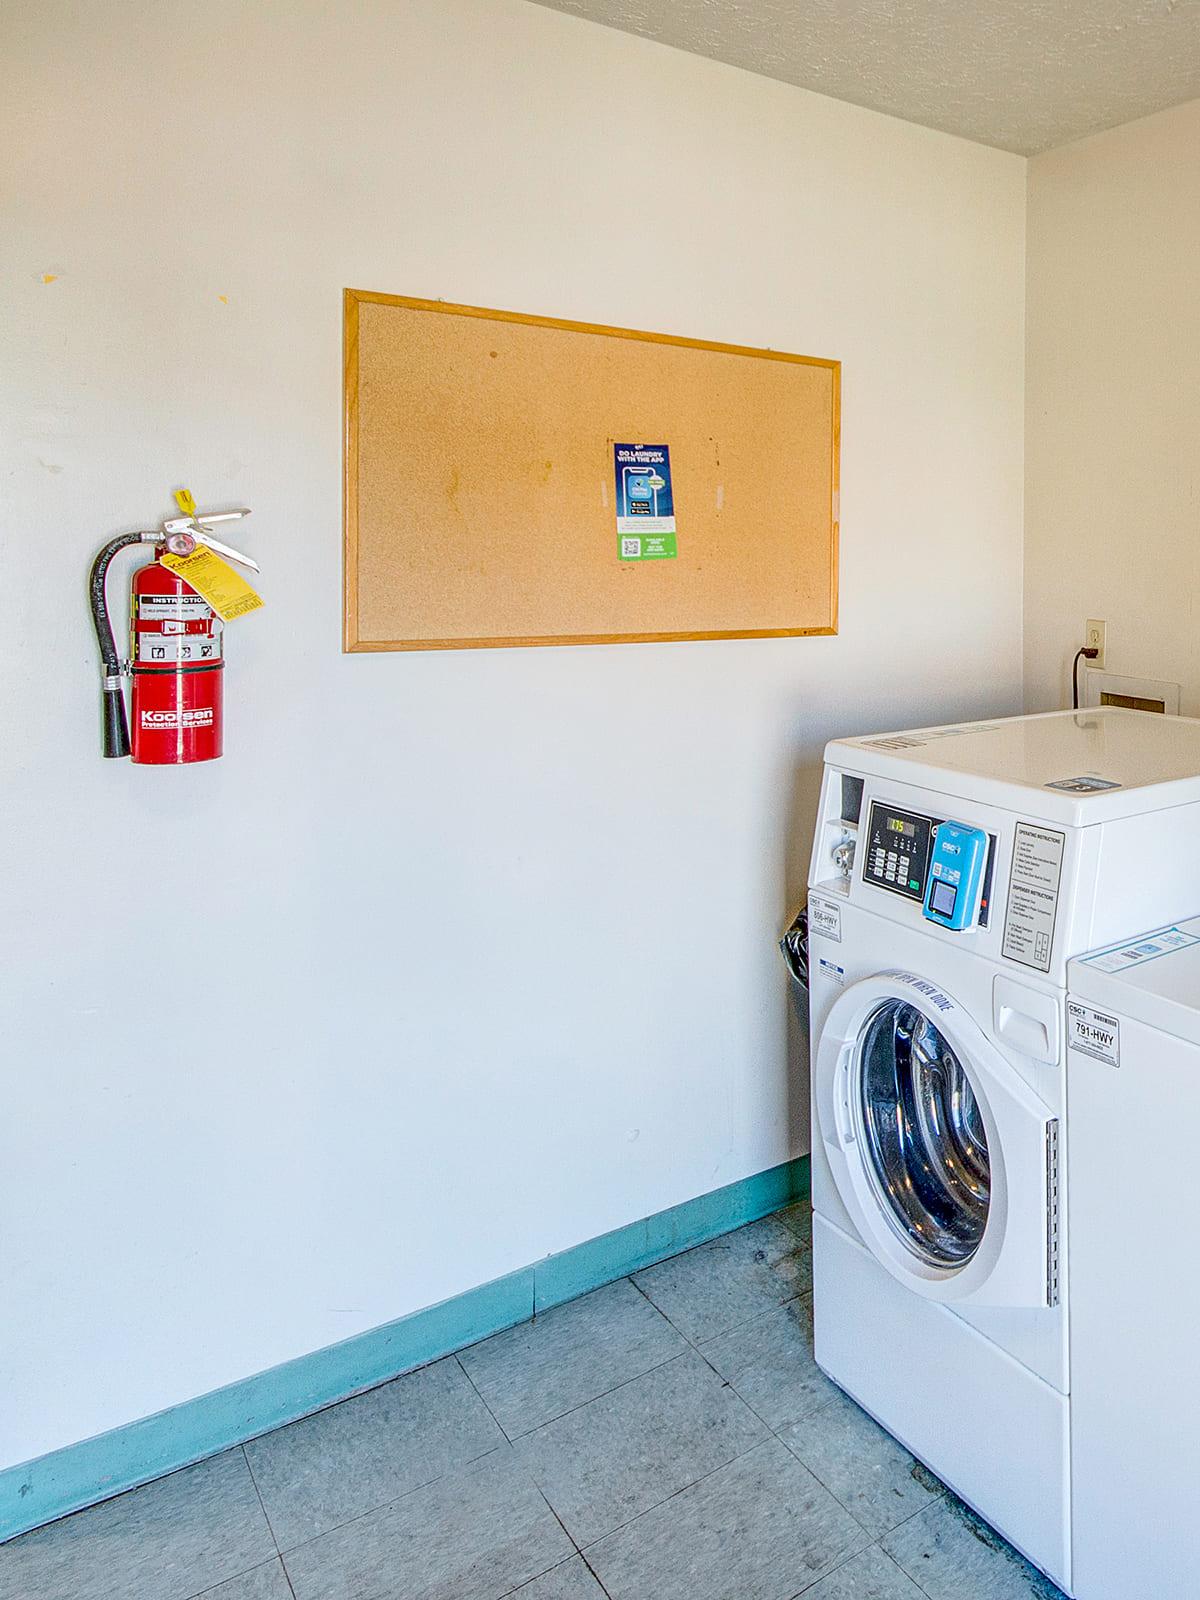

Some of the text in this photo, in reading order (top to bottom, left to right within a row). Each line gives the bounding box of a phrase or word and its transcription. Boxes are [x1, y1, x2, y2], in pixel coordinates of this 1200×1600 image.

[631, 450, 662, 458] LAUNDRY
[169, 552, 211, 568] Koorsen
[182, 719, 213, 727] Services
[1069, 1004, 1082, 1014] CSC
[1075, 1021, 1114, 1046] 791-HWY
